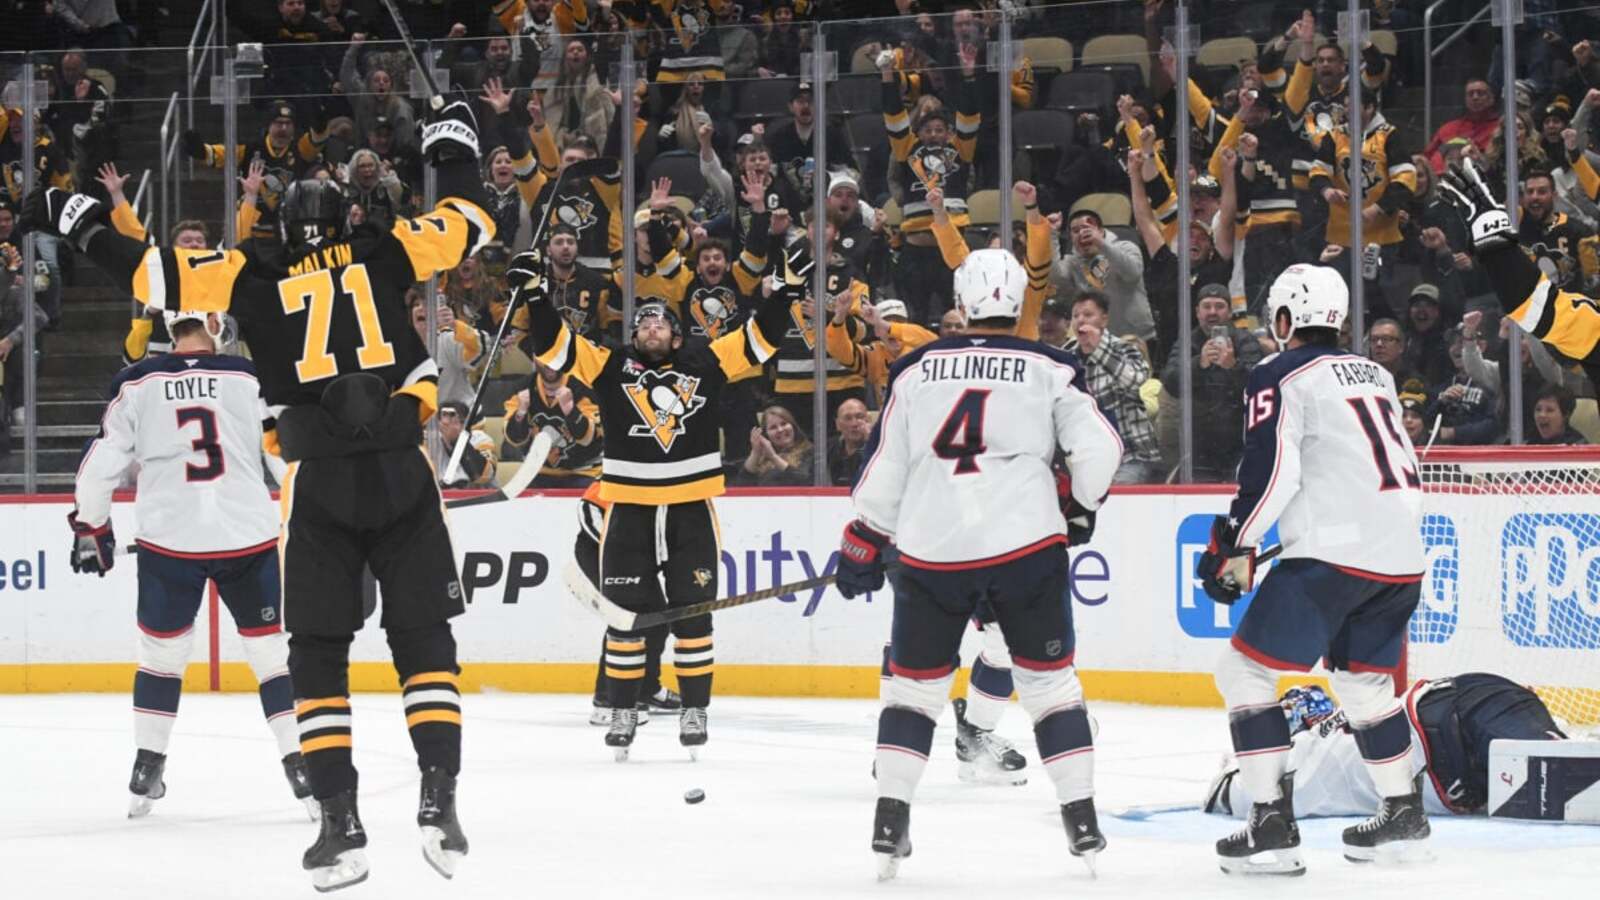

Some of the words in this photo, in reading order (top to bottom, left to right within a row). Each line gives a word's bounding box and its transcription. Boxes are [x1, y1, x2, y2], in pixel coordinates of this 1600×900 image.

[303, 224, 319, 239] 71
[288, 243, 352, 277] MALKIN
[992, 287, 1001, 301] 4
[277, 263, 396, 383] 71
[1325, 308, 1339, 324] 15
[921, 356, 1026, 383] SILLINGER
[164, 376, 218, 401] COYLE
[1247, 386, 1275, 431] 15
[176, 406, 225, 482] 3
[931, 387, 993, 475] 4
[1344, 395, 1422, 492] 15
[603, 576, 641, 585] CCM
[721, 530, 842, 617] nity
